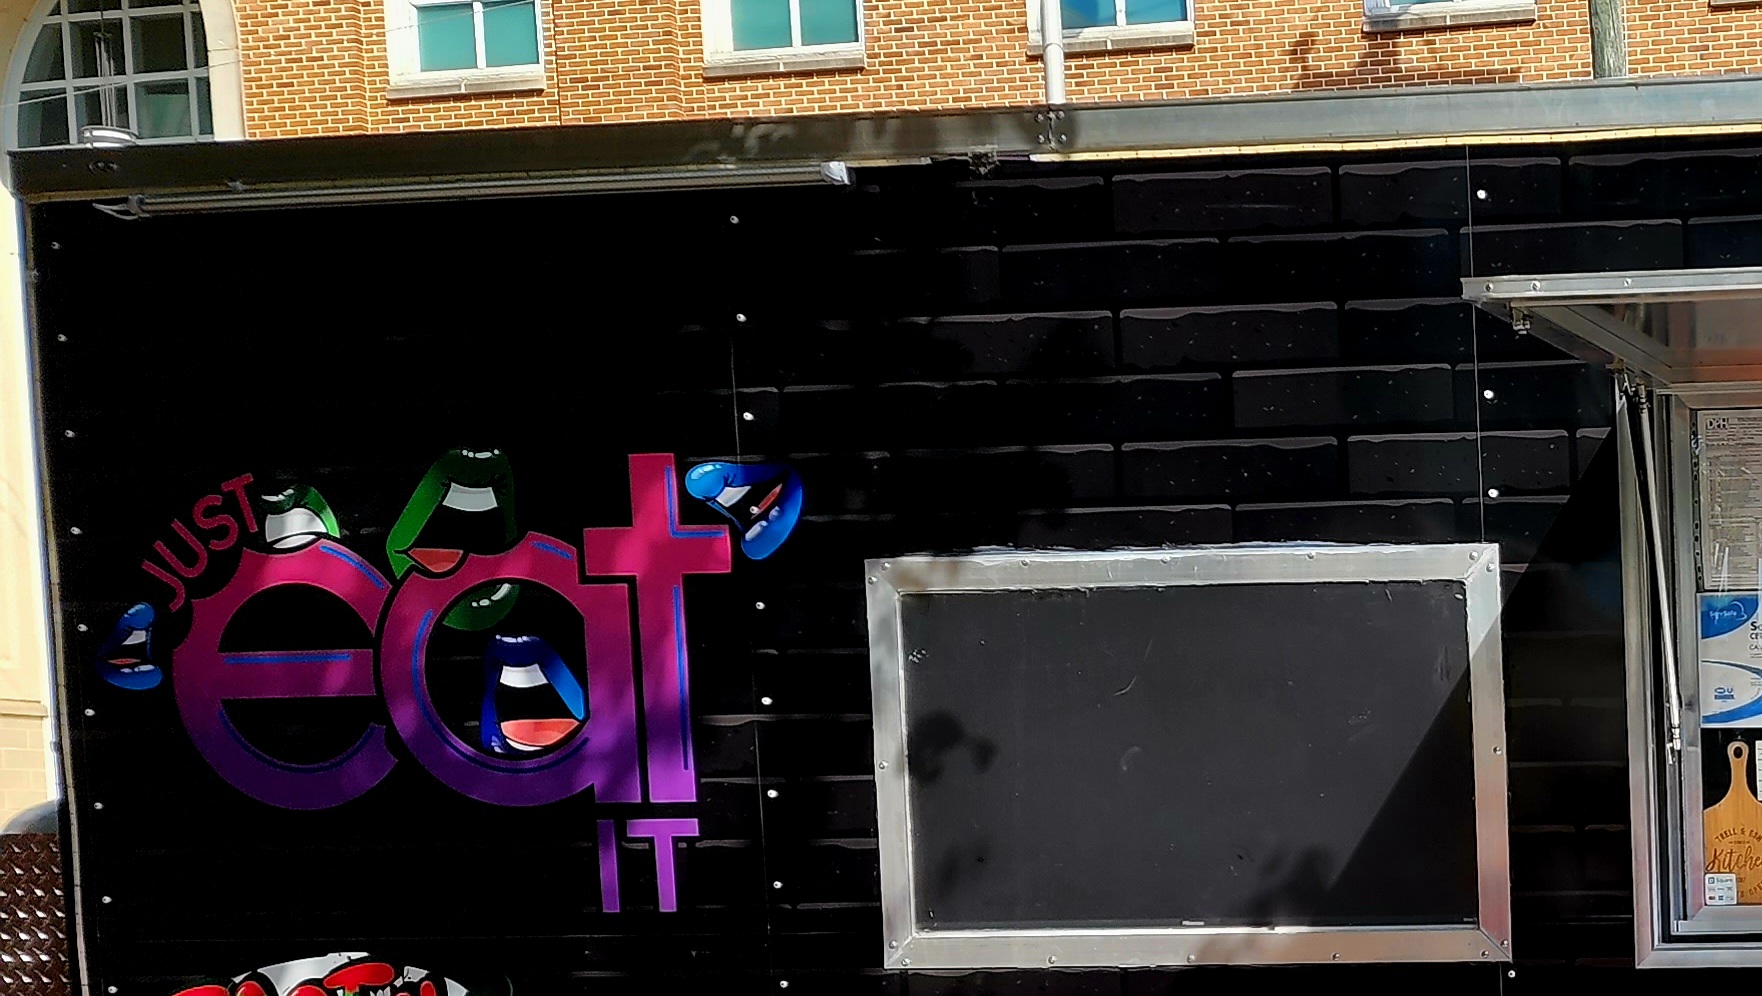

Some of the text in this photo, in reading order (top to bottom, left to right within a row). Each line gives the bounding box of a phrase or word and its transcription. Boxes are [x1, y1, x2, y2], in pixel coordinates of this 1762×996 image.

[142, 473, 258, 612] JUST
[172, 453, 732, 810] eat
[598, 818, 700, 912] IT
